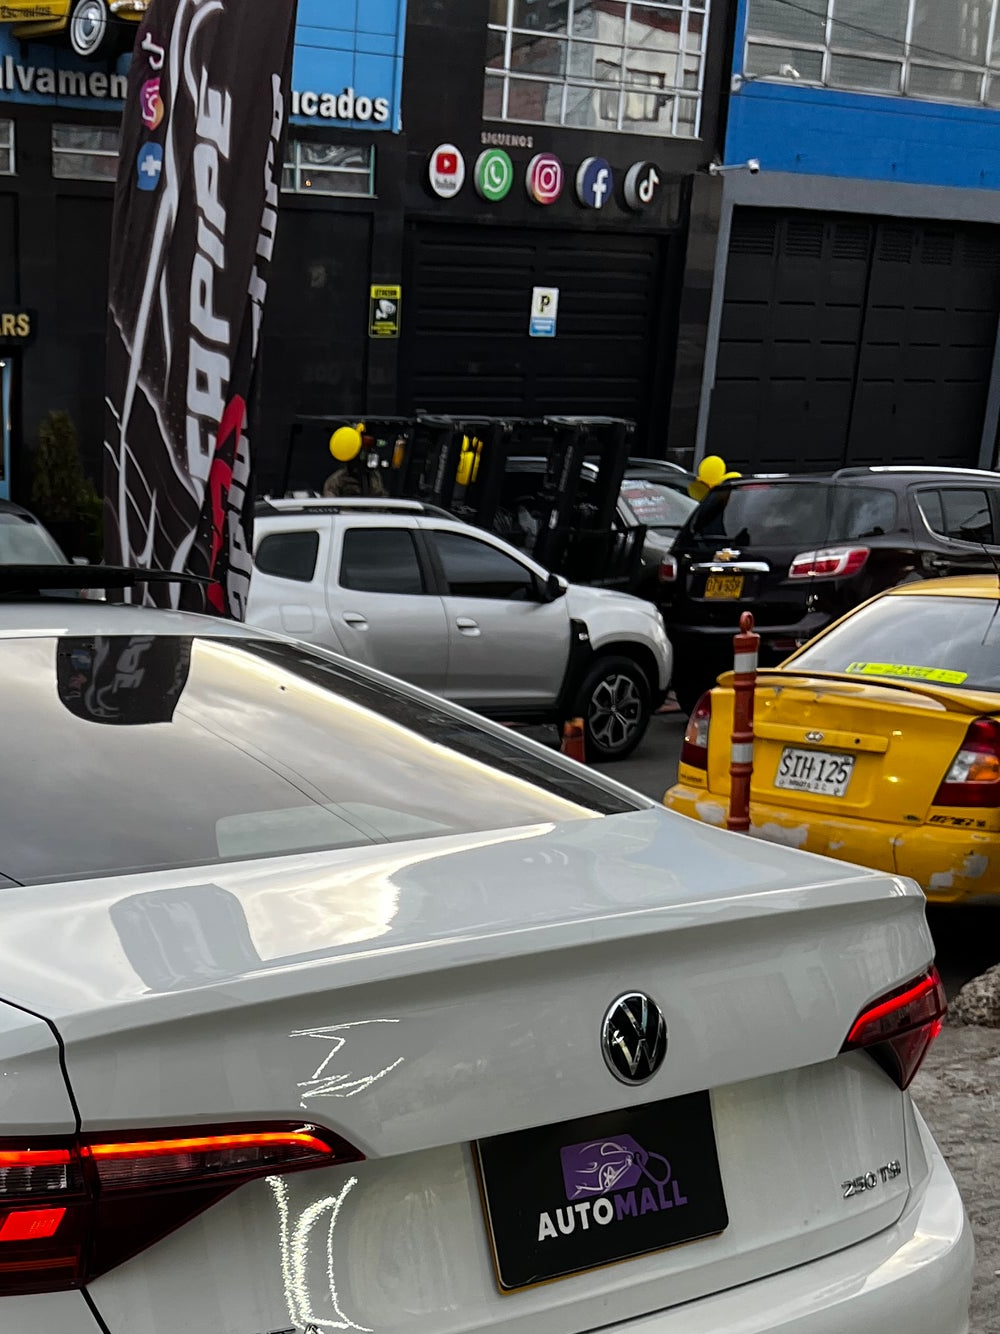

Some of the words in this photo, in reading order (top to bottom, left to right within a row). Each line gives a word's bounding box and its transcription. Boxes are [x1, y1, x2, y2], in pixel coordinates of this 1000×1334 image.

[292, 87, 390, 122] icados
[840, 1172, 877, 1199] 250
[537, 1180, 688, 1242] AUTOMALL
